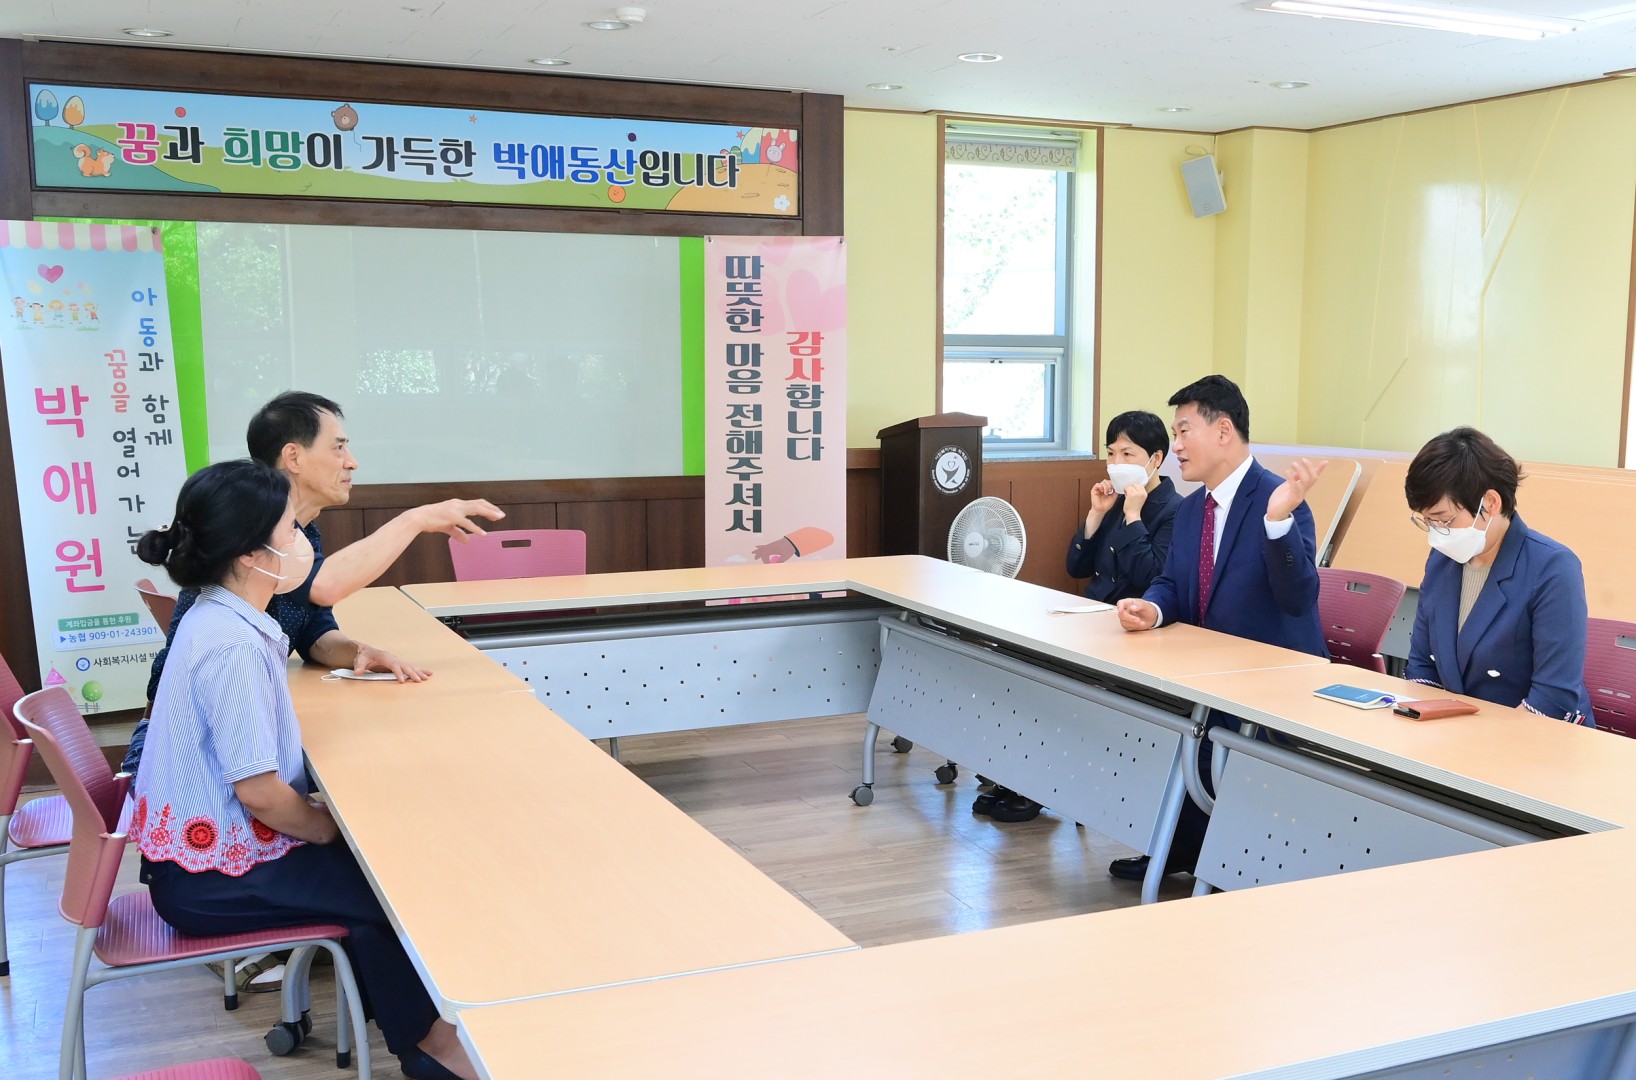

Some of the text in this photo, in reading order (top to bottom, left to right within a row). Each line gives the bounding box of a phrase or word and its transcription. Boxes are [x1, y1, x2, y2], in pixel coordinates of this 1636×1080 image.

[117, 122, 740, 189] 꿈과 희망이 가득한 박애동산입니다
[103, 349, 131, 413] 꿈을
[131, 287, 173, 446] 아동과 함께
[725, 255, 765, 534] 따뜻한 마음 전해주셔서
[784, 331, 825, 461] 감사합니다
[112, 427, 141, 478] 열어
[34, 385, 106, 593] 박애원
[65, 615, 131, 628] 계좌입금을 통한 후원
[68, 627, 157, 643] 농협 909-01-243901
[93, 652, 147, 667] 사회복지시설
